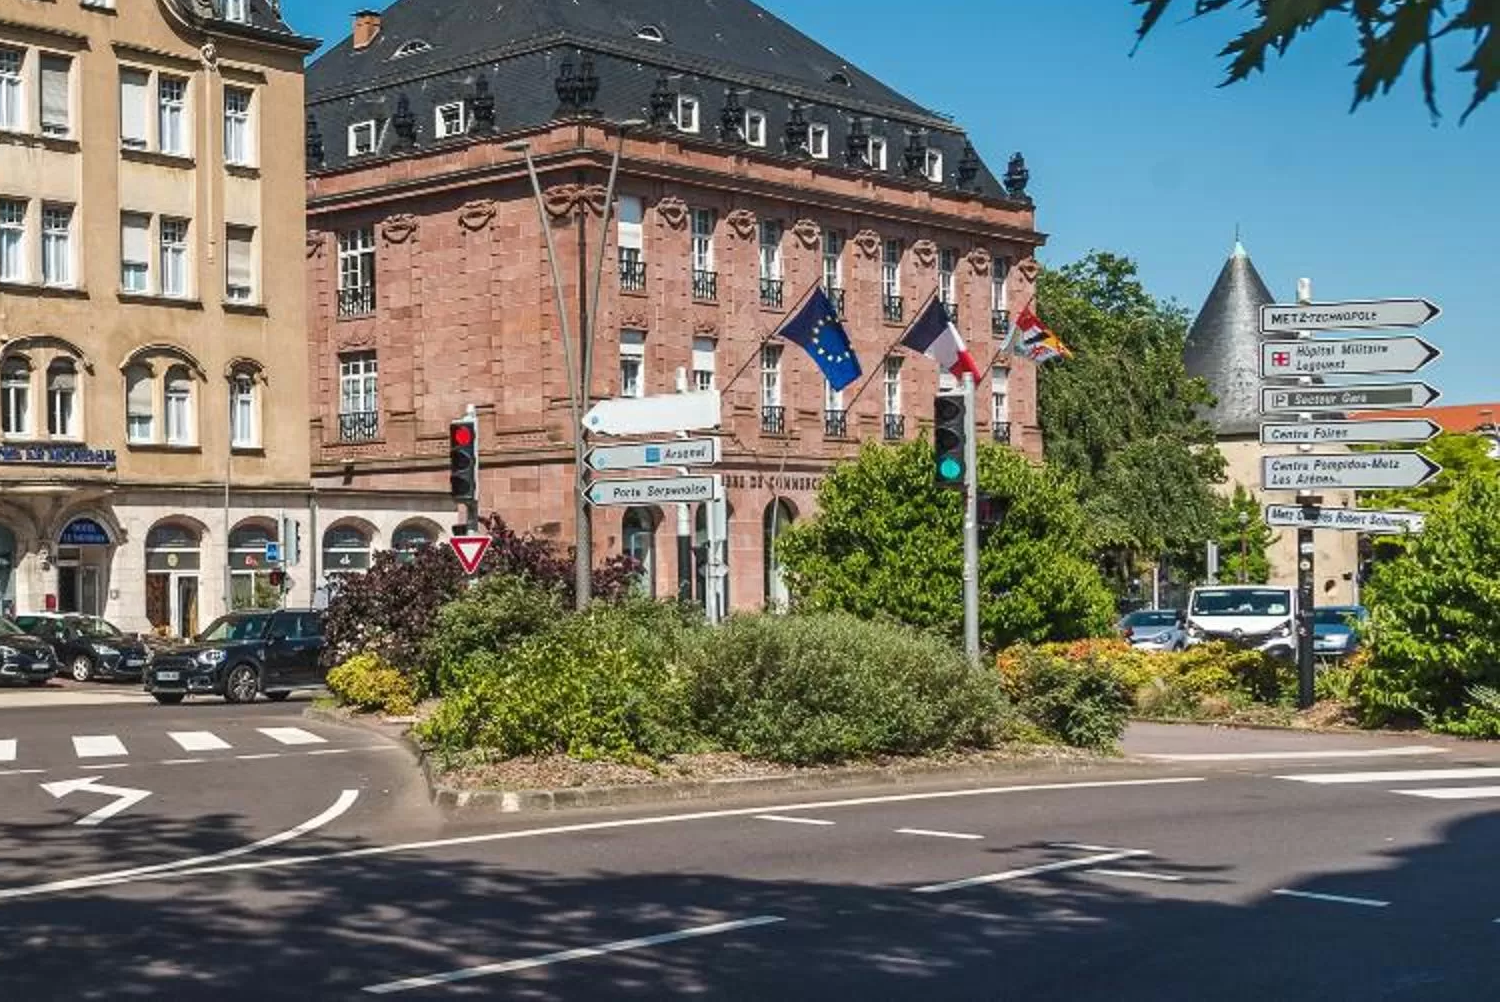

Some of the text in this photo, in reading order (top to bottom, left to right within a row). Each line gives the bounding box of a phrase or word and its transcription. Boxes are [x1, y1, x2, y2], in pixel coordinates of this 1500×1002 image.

[1271, 312, 1377, 325] METZ-TECHNOPOLE
[1271, 428, 1309, 439] Centre
[665, 447, 706, 458] Arsenal
[1271, 458, 1400, 471] Centre Pompidou-Metz
[1271, 475, 1291, 484] Les
[613, 484, 707, 498] Porte Serpenoise
[1271, 507, 1293, 520] Metz
[1335, 512, 1366, 525] Robert
